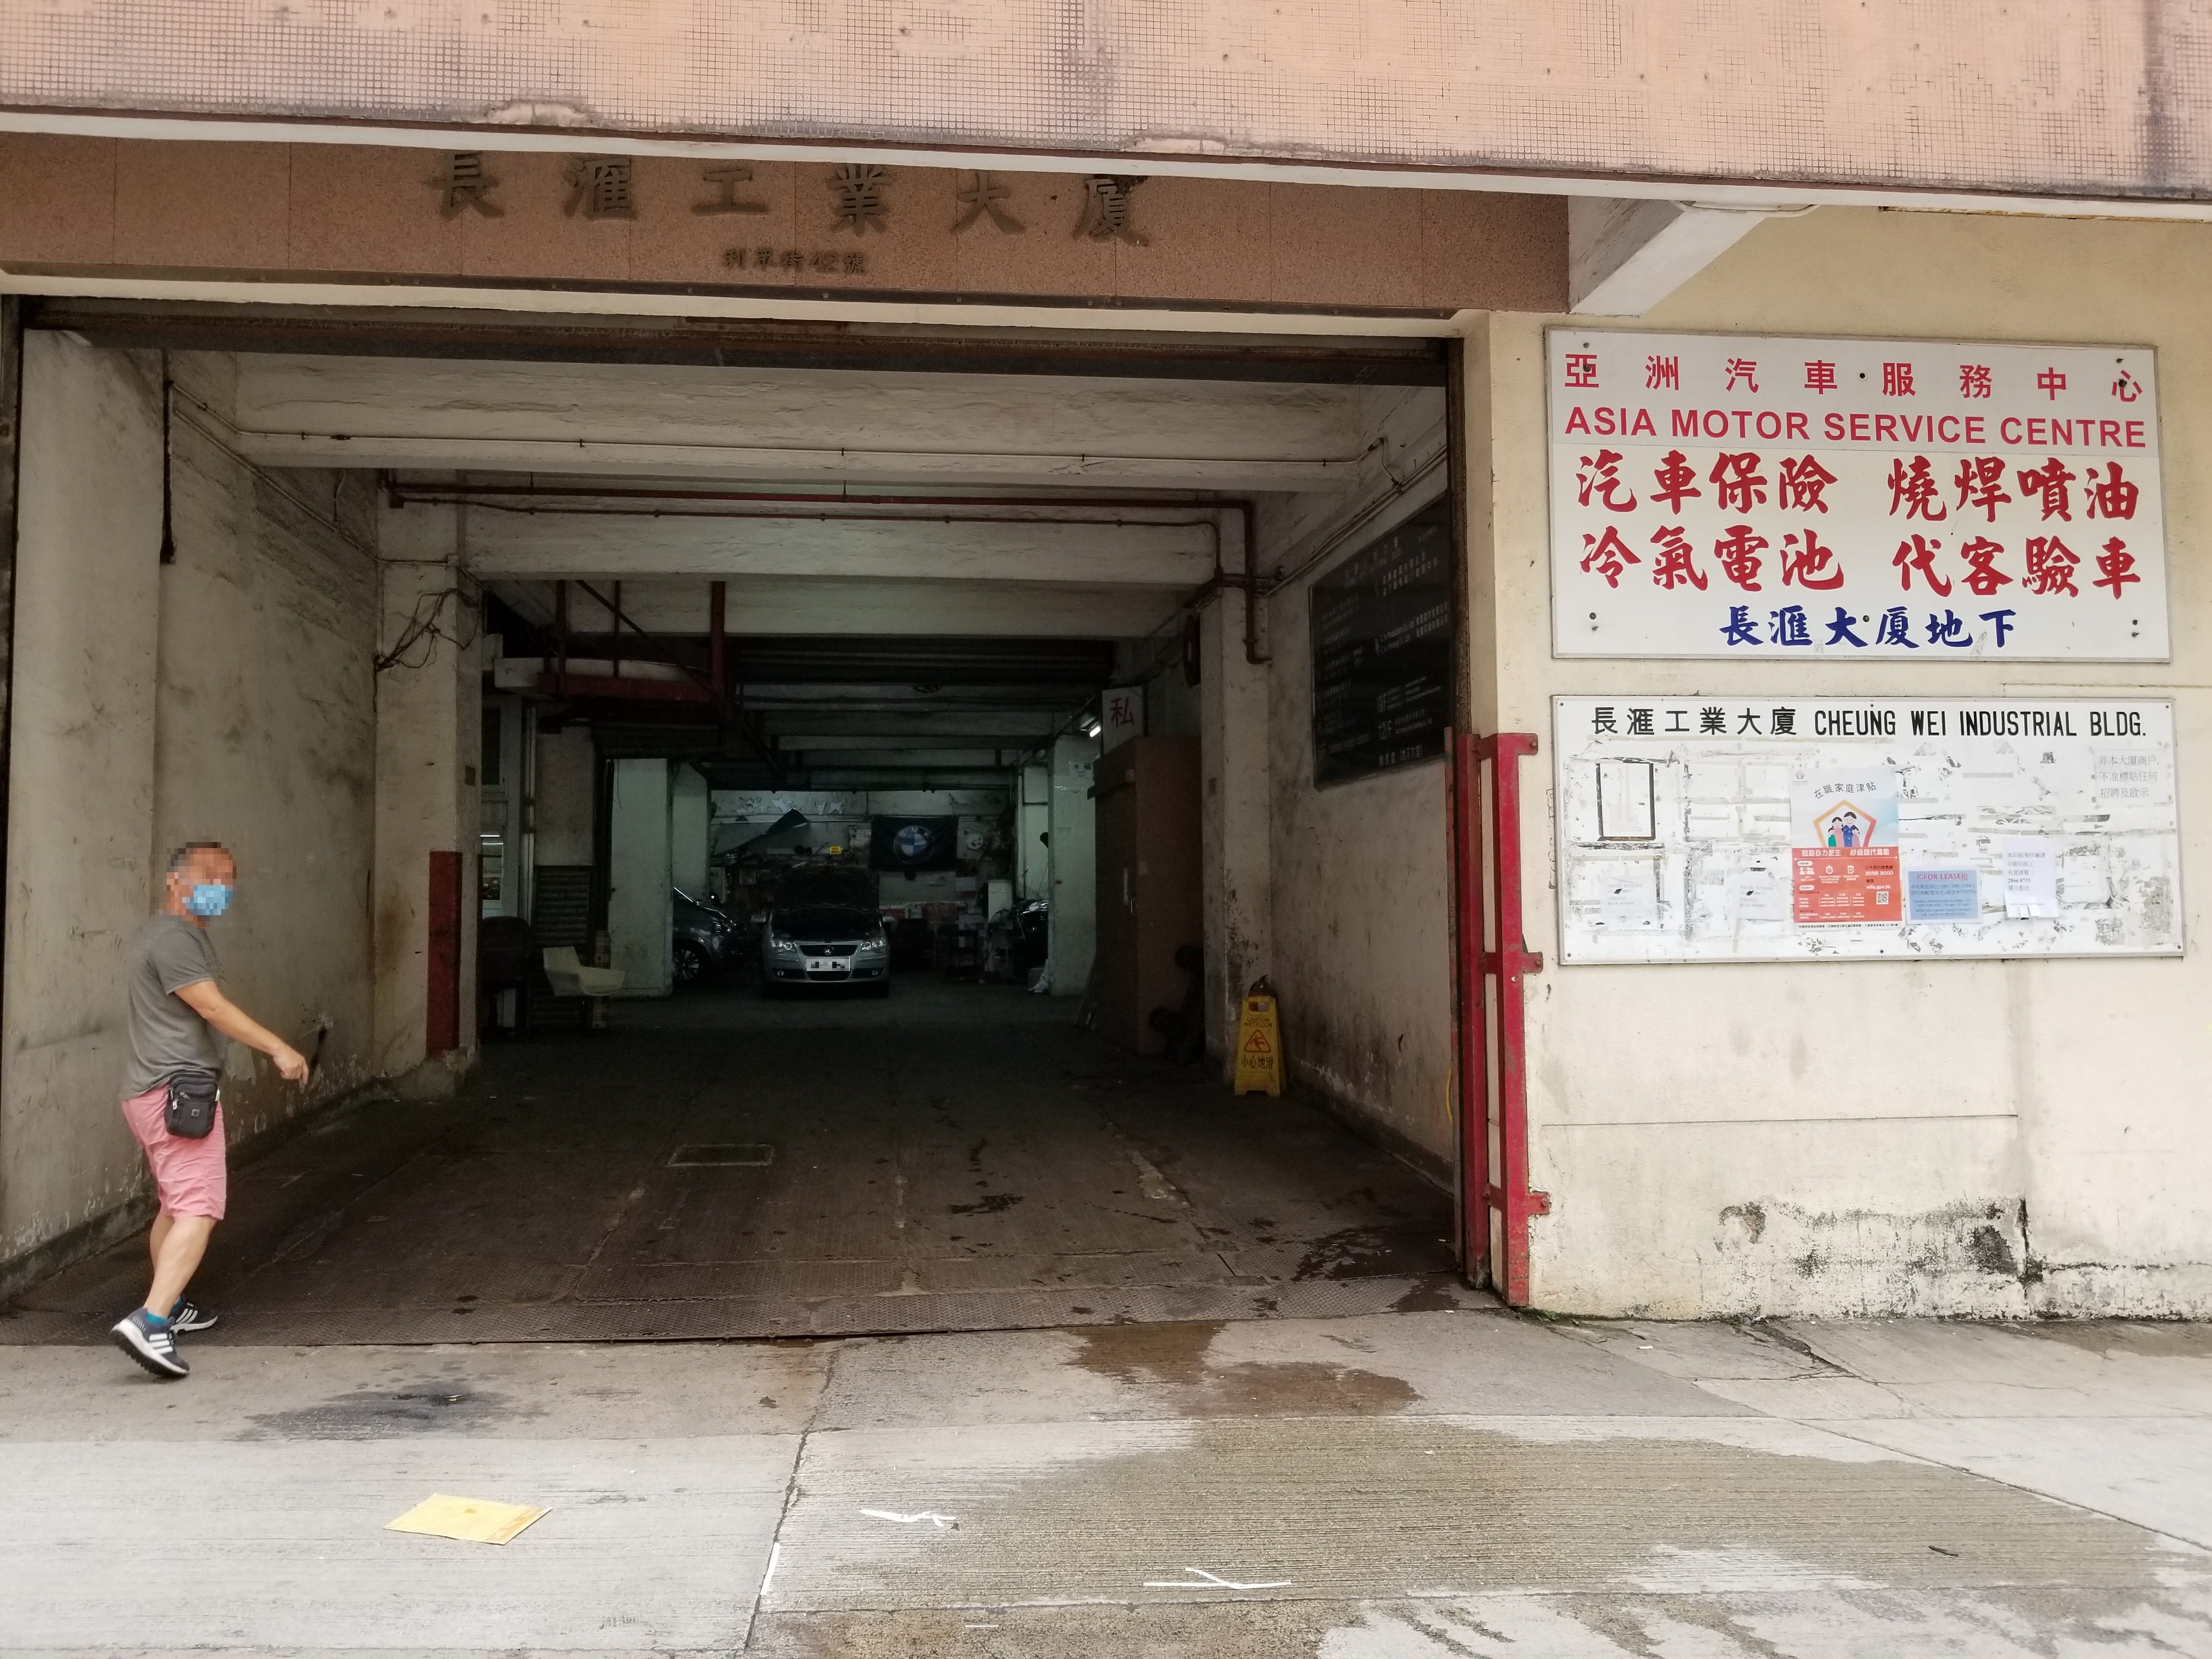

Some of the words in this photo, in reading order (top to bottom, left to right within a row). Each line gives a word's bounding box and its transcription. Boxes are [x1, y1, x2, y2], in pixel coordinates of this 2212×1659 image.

[1565, 354, 2142, 402] 亞洲汽車服務中心
[1565, 407, 1657, 436] ASIA
[1672, 409, 1810, 440] MOTOR
[1824, 413, 1985, 443] SERVICE
[2000, 417, 2146, 448] CENTRE
[1576, 449, 1838, 515] 汽車保險
[1888, 455, 2138, 522] 燒焊噴油
[1579, 525, 1844, 591] 冷氣電池
[1892, 534, 2141, 600] 代客驗車
[1110, 697, 1135, 728] 私
[1815, 710, 1896, 736] CHEUNG
[1911, 711, 1946, 736] WEI
[1960, 711, 2078, 736] INDUSTRIAL
[2090, 712, 2146, 736] BLDG.
[1813, 781, 1877, 799] 在職家庭津貼
[1242, 1054, 1273, 1070] 小心地滑
